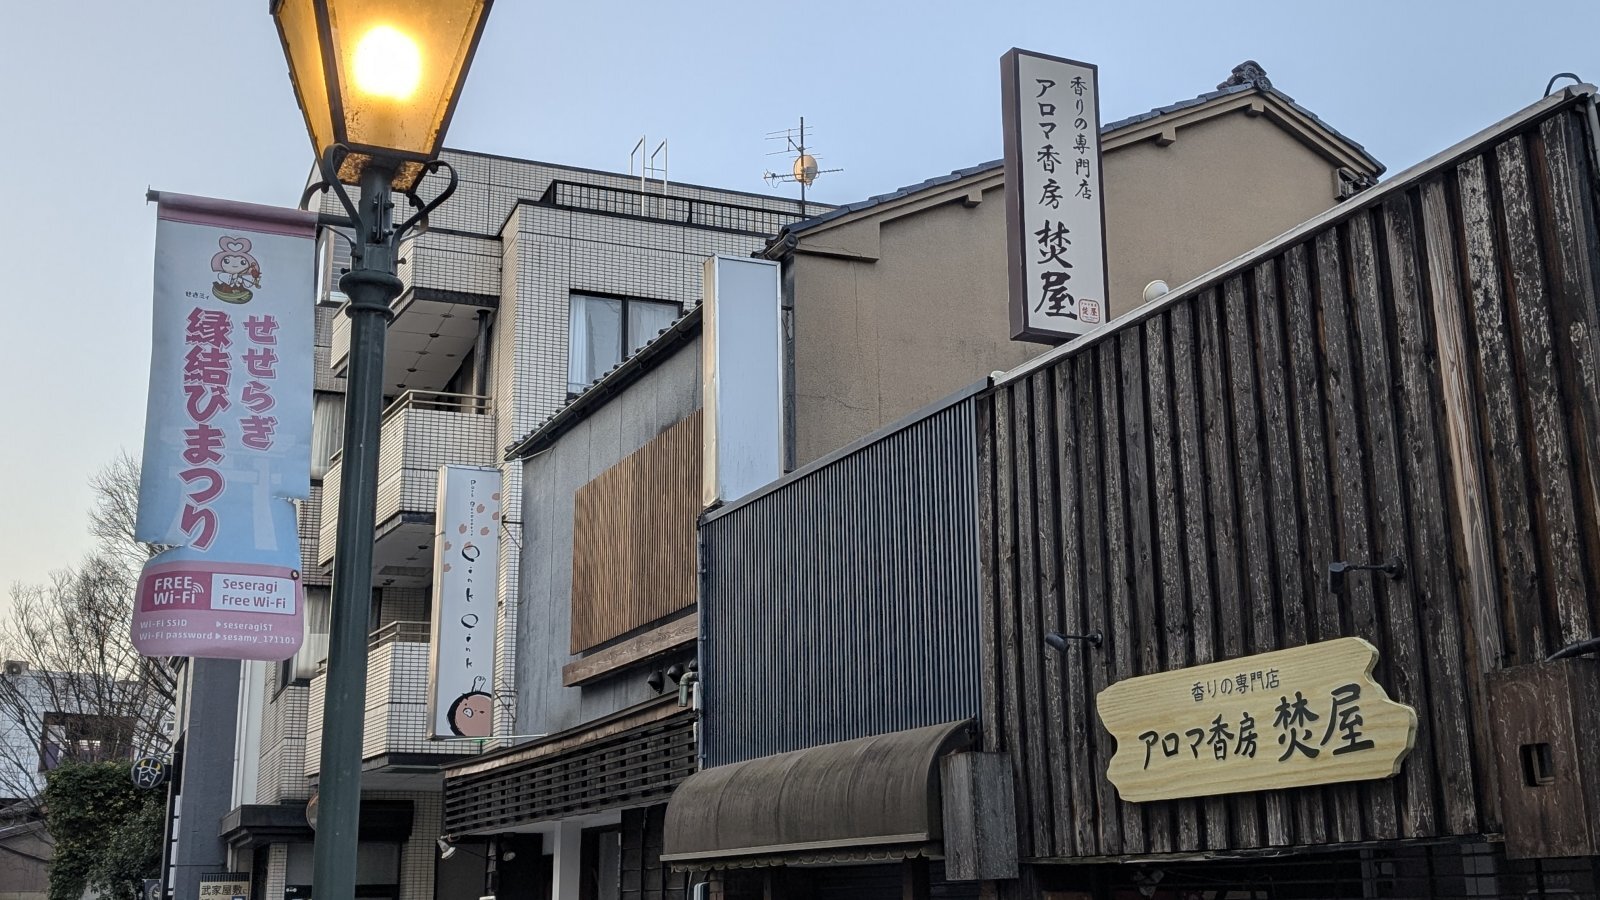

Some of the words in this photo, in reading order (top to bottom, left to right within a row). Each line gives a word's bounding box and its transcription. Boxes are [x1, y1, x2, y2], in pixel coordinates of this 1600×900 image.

[1035, 77, 1064, 210] アロマ香房
[1070, 76, 1092, 200] 香りの専門店
[1034, 219, 1078, 321] 焚屋
[240, 314, 280, 451] せせらぎ
[179, 307, 233, 550] 縁結びまつり
[154, 590, 195, 606] Wi-Fi
[155, 576, 192, 591] FREE
[222, 578, 278, 594] Seseragi
[222, 594, 249, 607] Free
[254, 596, 286, 609] Wi-Fi
[461, 545, 480, 602] Oink
[139, 631, 164, 641] Wi-Fi
[166, 630, 213, 641] password
[222, 634, 295, 645] sesamy_171101
[140, 620, 164, 629] Wi-Fi
[166, 619, 188, 627] SSID
[460, 613, 479, 669] Oink
[1191, 668, 1280, 703] 香りの専門店
[1138, 711, 1258, 770] アロマ香房
[1273, 683, 1375, 762] 焚屋
